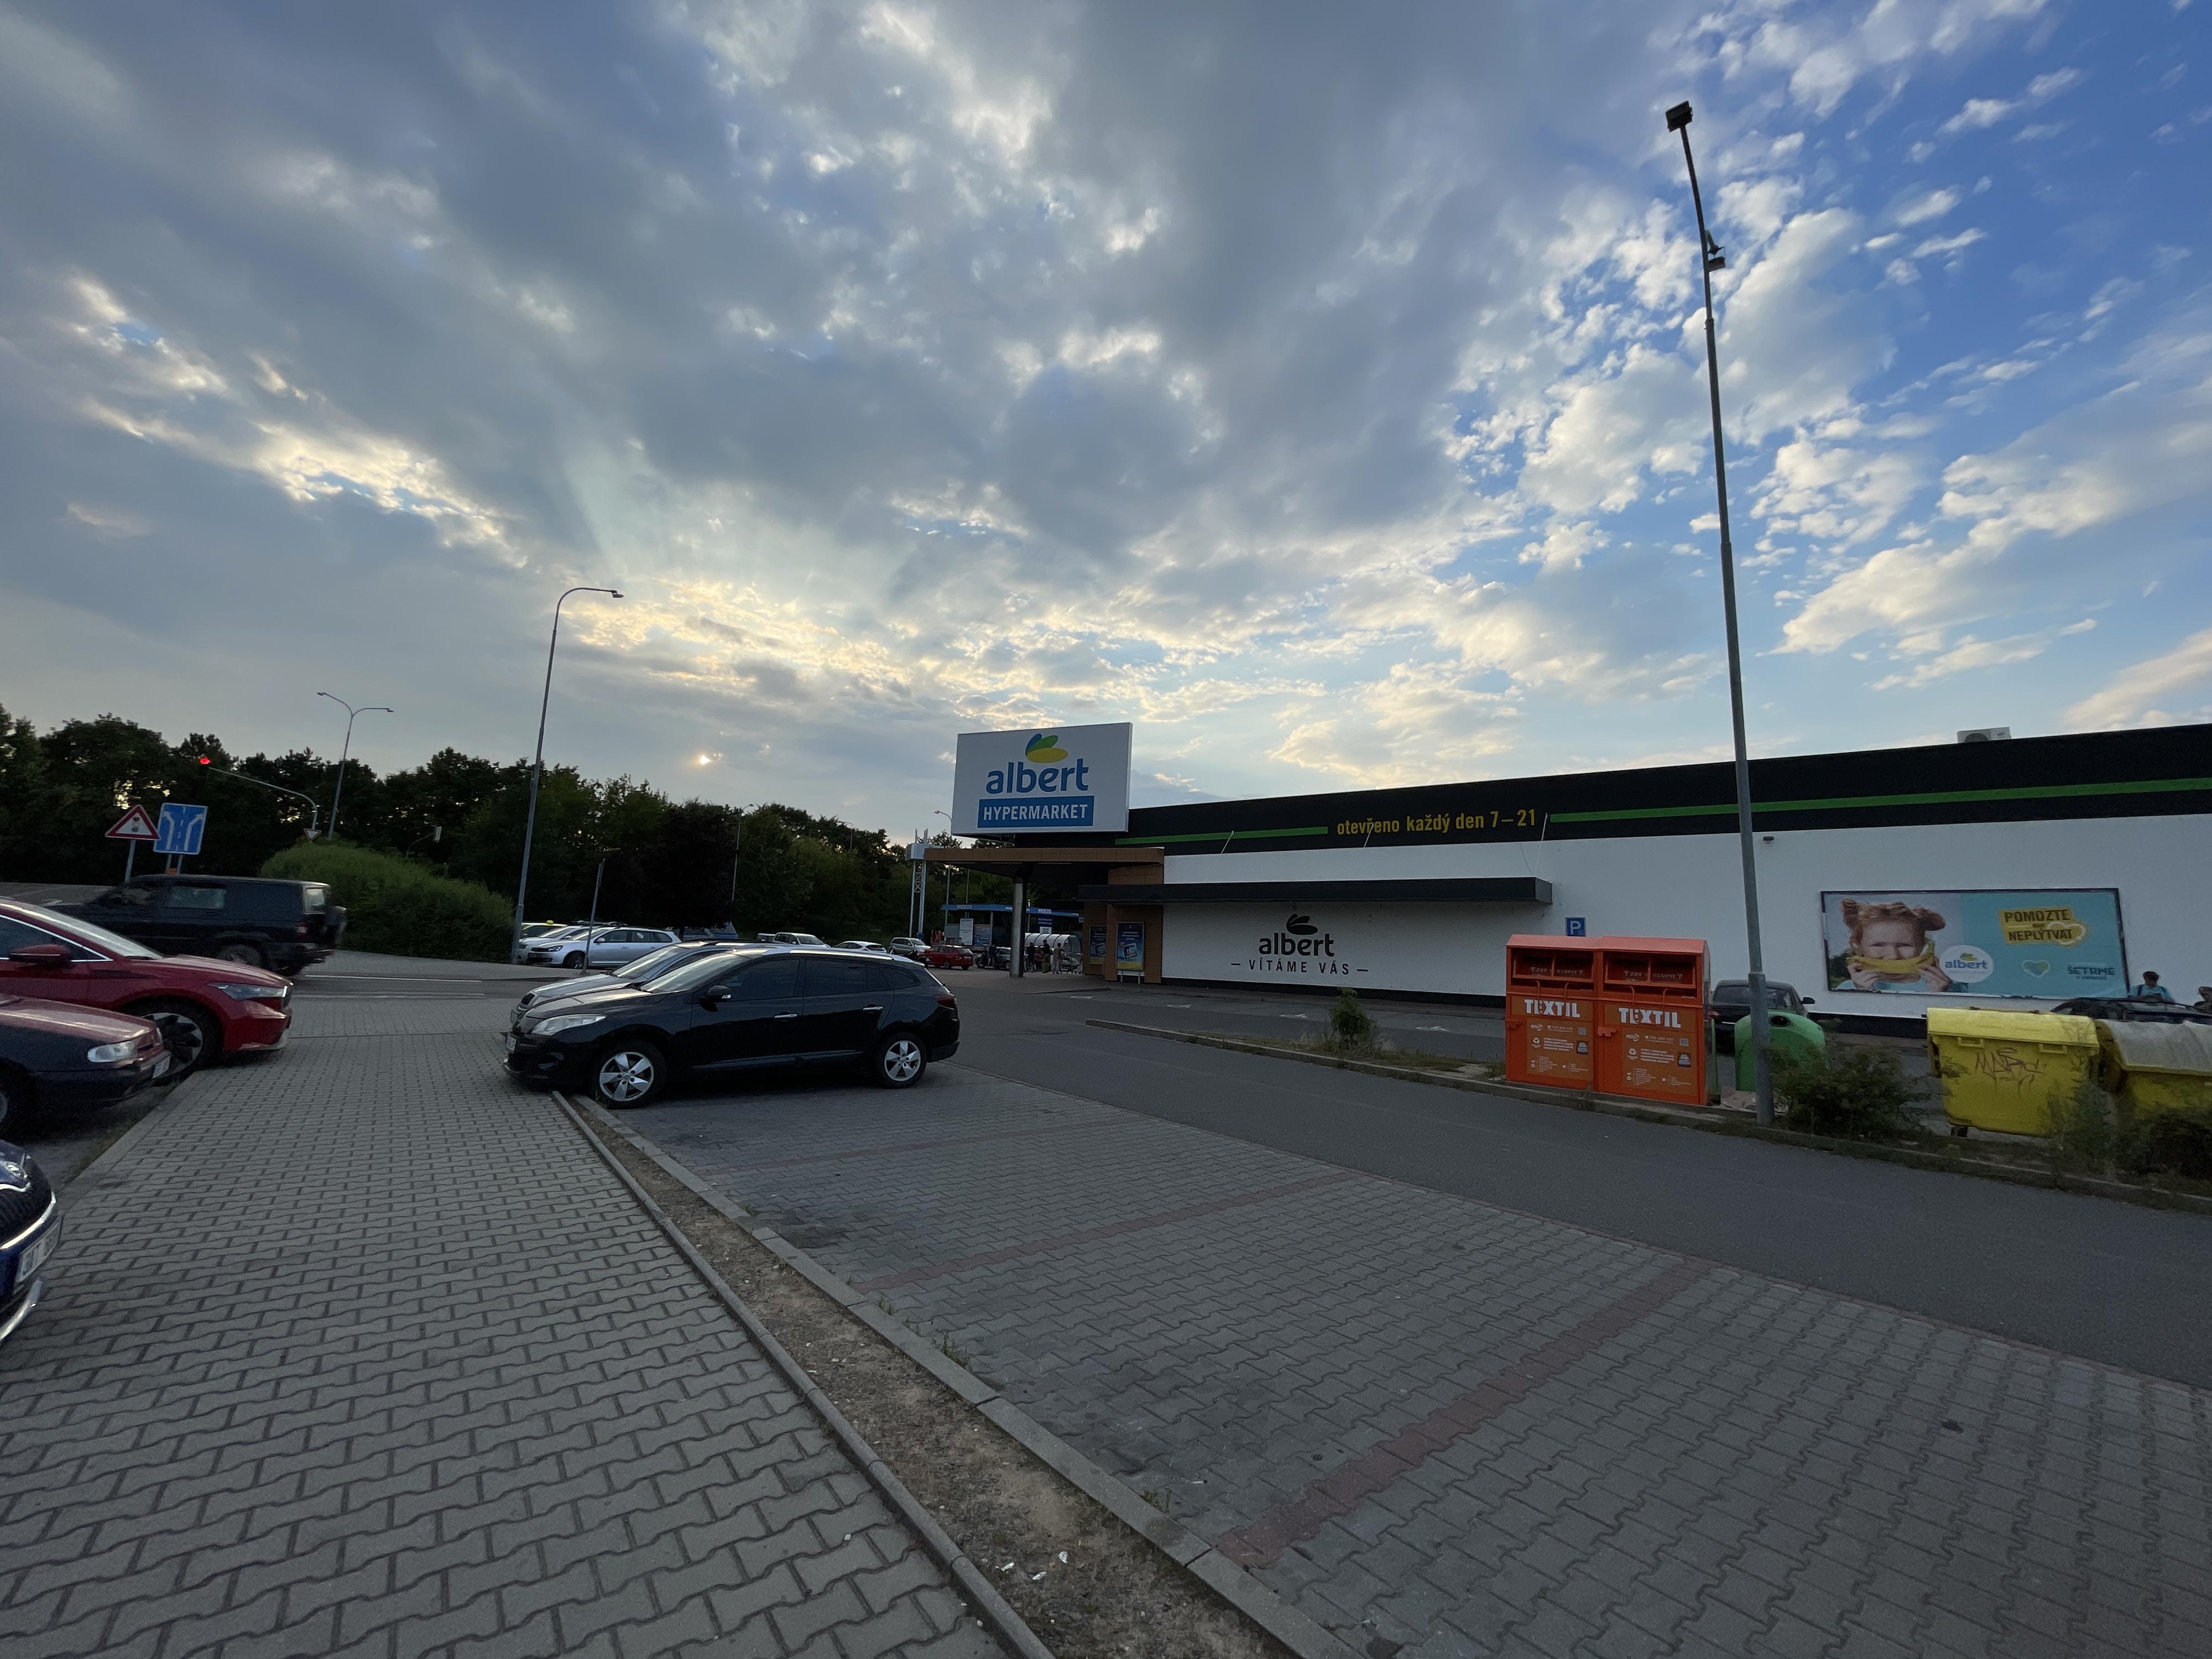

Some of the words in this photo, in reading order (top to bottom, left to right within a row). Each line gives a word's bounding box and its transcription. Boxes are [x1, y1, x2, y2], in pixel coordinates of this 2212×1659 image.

[986, 758, 1089, 794] albert
[983, 804, 1088, 821] HYPERMARKET
[1337, 818, 1400, 835] otevřeno
[1406, 813, 1450, 833] každý
[1455, 813, 1484, 830] den
[2004, 910, 2071, 922] POMOZTE
[2008, 928, 2072, 941] NEPLÝTVAT
[1259, 932, 1334, 957] albert
[1249, 958, 1307, 973] VÍTÁME
[1319, 960, 1349, 975] VÁS
[1945, 959, 1987, 969] albert
[1524, 999, 1580, 1018] TEXTIL
[1619, 1007, 1681, 1029] TEXTIL
